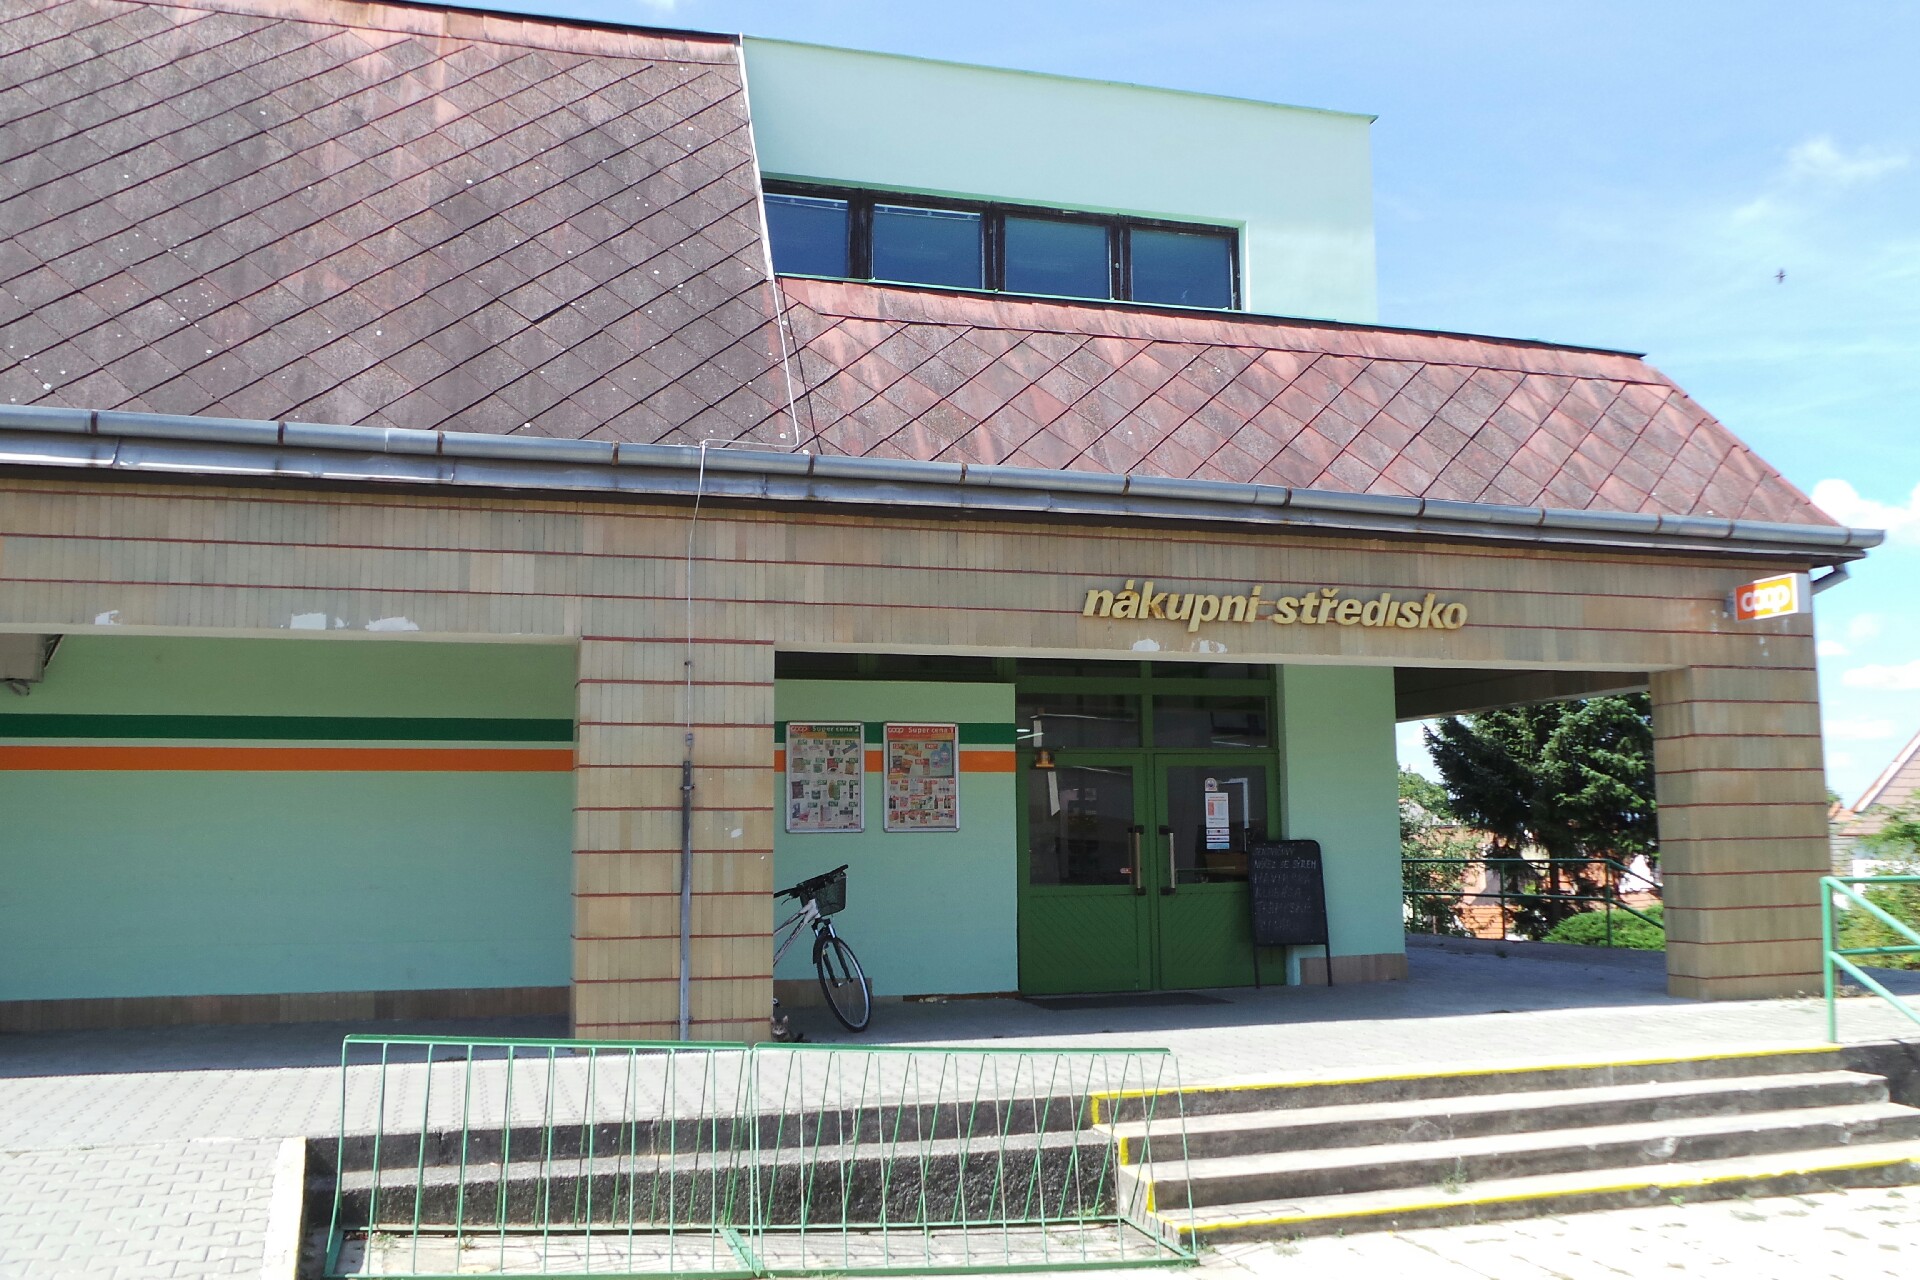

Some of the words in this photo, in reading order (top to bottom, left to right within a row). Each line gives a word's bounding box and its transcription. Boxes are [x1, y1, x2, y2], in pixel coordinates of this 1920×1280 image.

[1083, 579, 1264, 633] nákupní
[1741, 584, 1791, 613] coop
[812, 725, 834, 734] Super
[908, 726, 930, 735] Super
